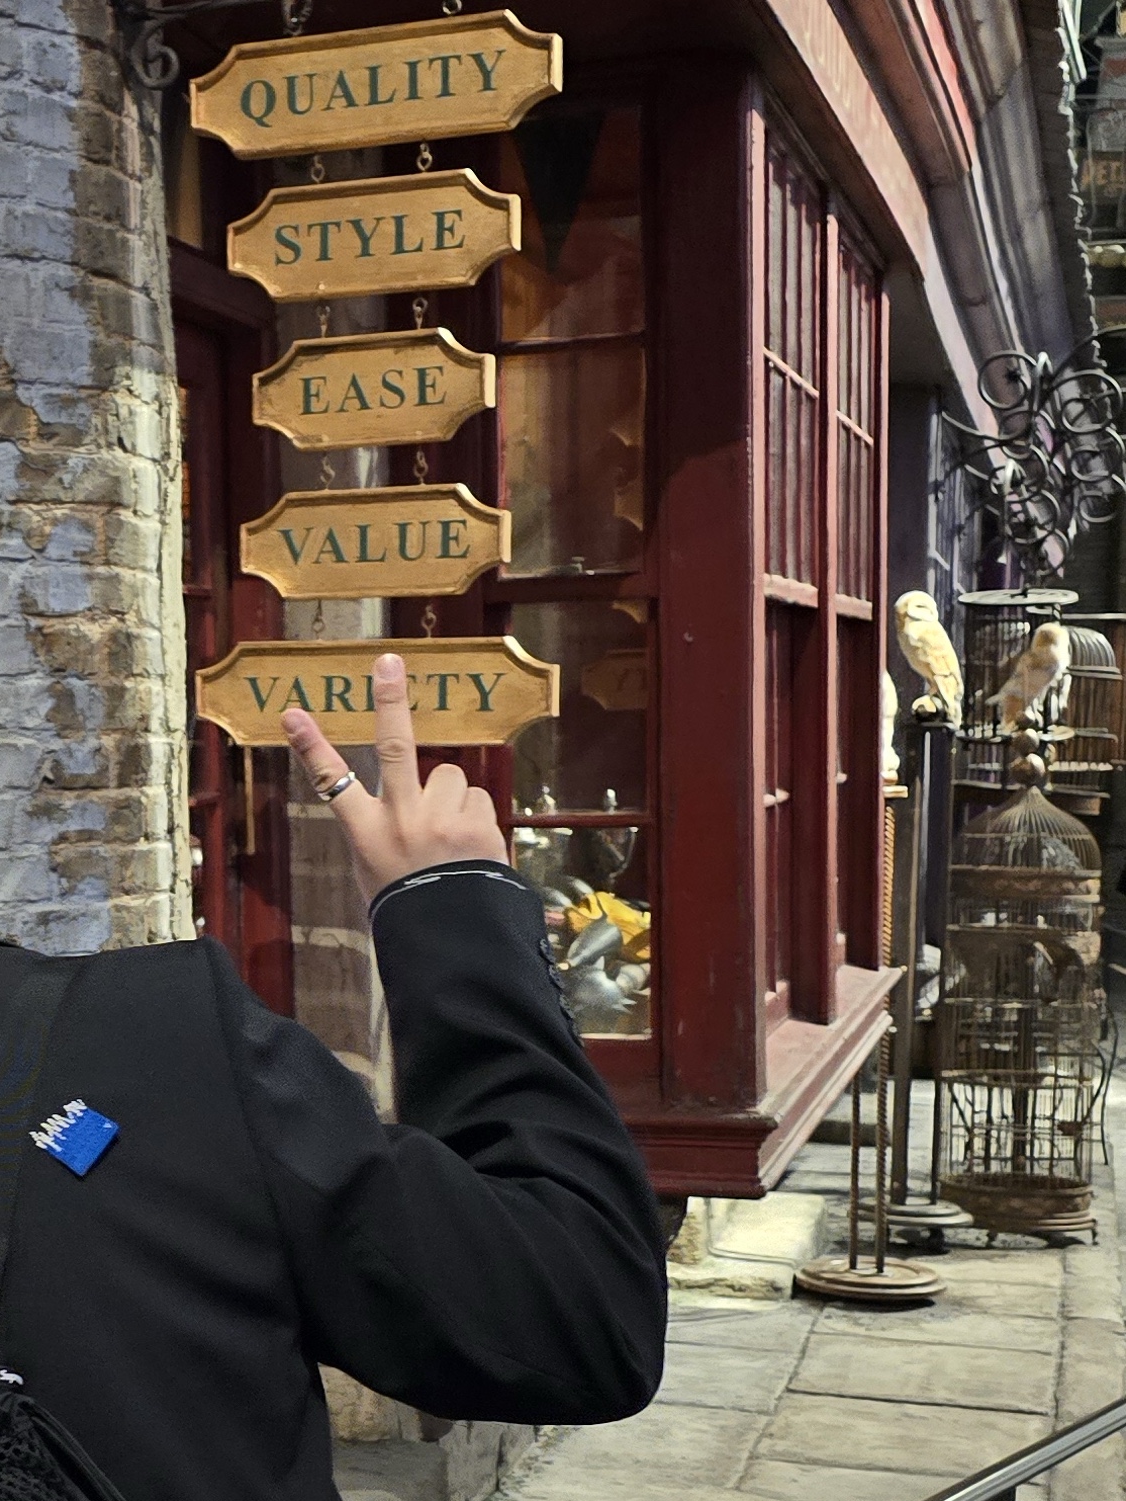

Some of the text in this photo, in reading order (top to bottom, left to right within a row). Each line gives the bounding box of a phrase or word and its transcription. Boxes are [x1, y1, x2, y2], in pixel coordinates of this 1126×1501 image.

[240, 50, 505, 128] QUALITY
[274, 210, 466, 267] STYLE
[298, 365, 447, 416] EASE
[277, 519, 471, 566] VALUE
